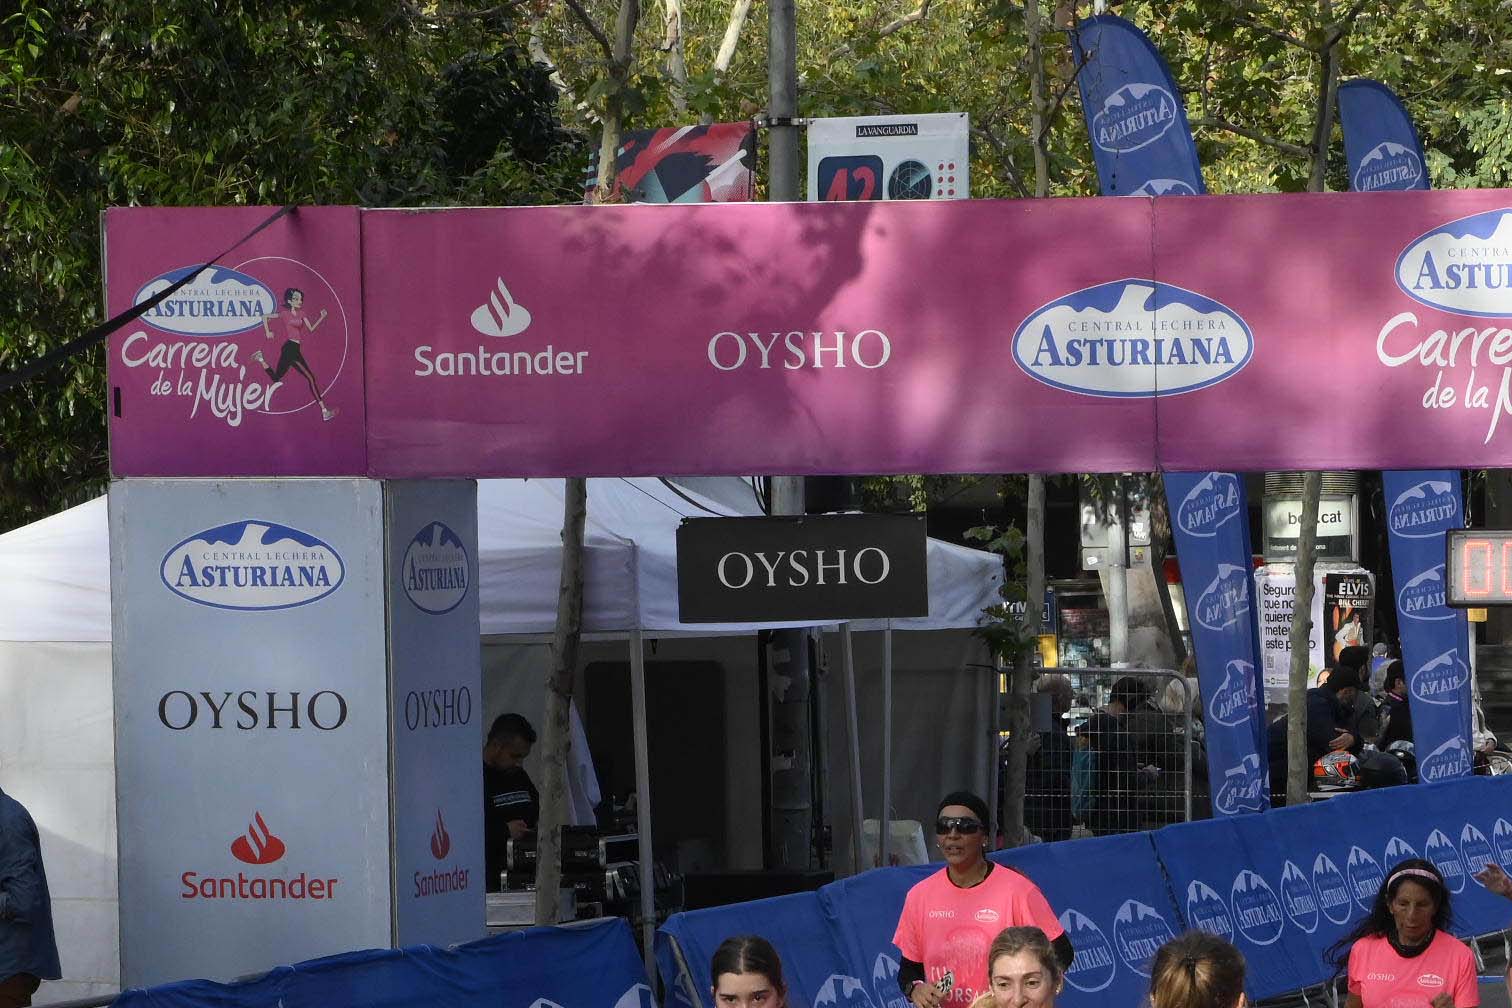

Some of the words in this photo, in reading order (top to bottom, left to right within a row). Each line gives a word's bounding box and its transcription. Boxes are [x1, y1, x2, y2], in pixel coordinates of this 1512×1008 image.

[173, 287, 210, 297] ENTRAL
[216, 287, 261, 297] LECHERA
[1068, 320, 1144, 332] CENTRAL
[1151, 319, 1227, 332] LECHERA
[121, 331, 239, 369] Carrera
[414, 345, 589, 378] Santander
[706, 329, 892, 371] OYSHO
[1030, 324, 1236, 368] ASTURIANA
[150, 375, 172, 397] de
[177, 375, 193, 397] la
[191, 366, 283, 427] Mujer
[1422, 371, 1457, 409] de
[1464, 371, 1489, 409] la
[1288, 510, 1342, 525] b.cat
[174, 554, 332, 588] ASTURIANA
[202, 552, 261, 562] CENTRAL
[266, 551, 325, 561] LECHERA
[716, 546, 891, 590] OYSHO
[408, 558, 466, 594] ASTURIANA
[1338, 582, 1370, 596] ELVIS
[1264, 600, 1280, 611] que
[1264, 613, 1295, 623] quiere
[1265, 639, 1284, 650] este
[158, 690, 348, 731] OYSHO
[405, 685, 472, 731] OYSHO
[181, 871, 338, 900] Santander
[413, 864, 469, 899] Santander
